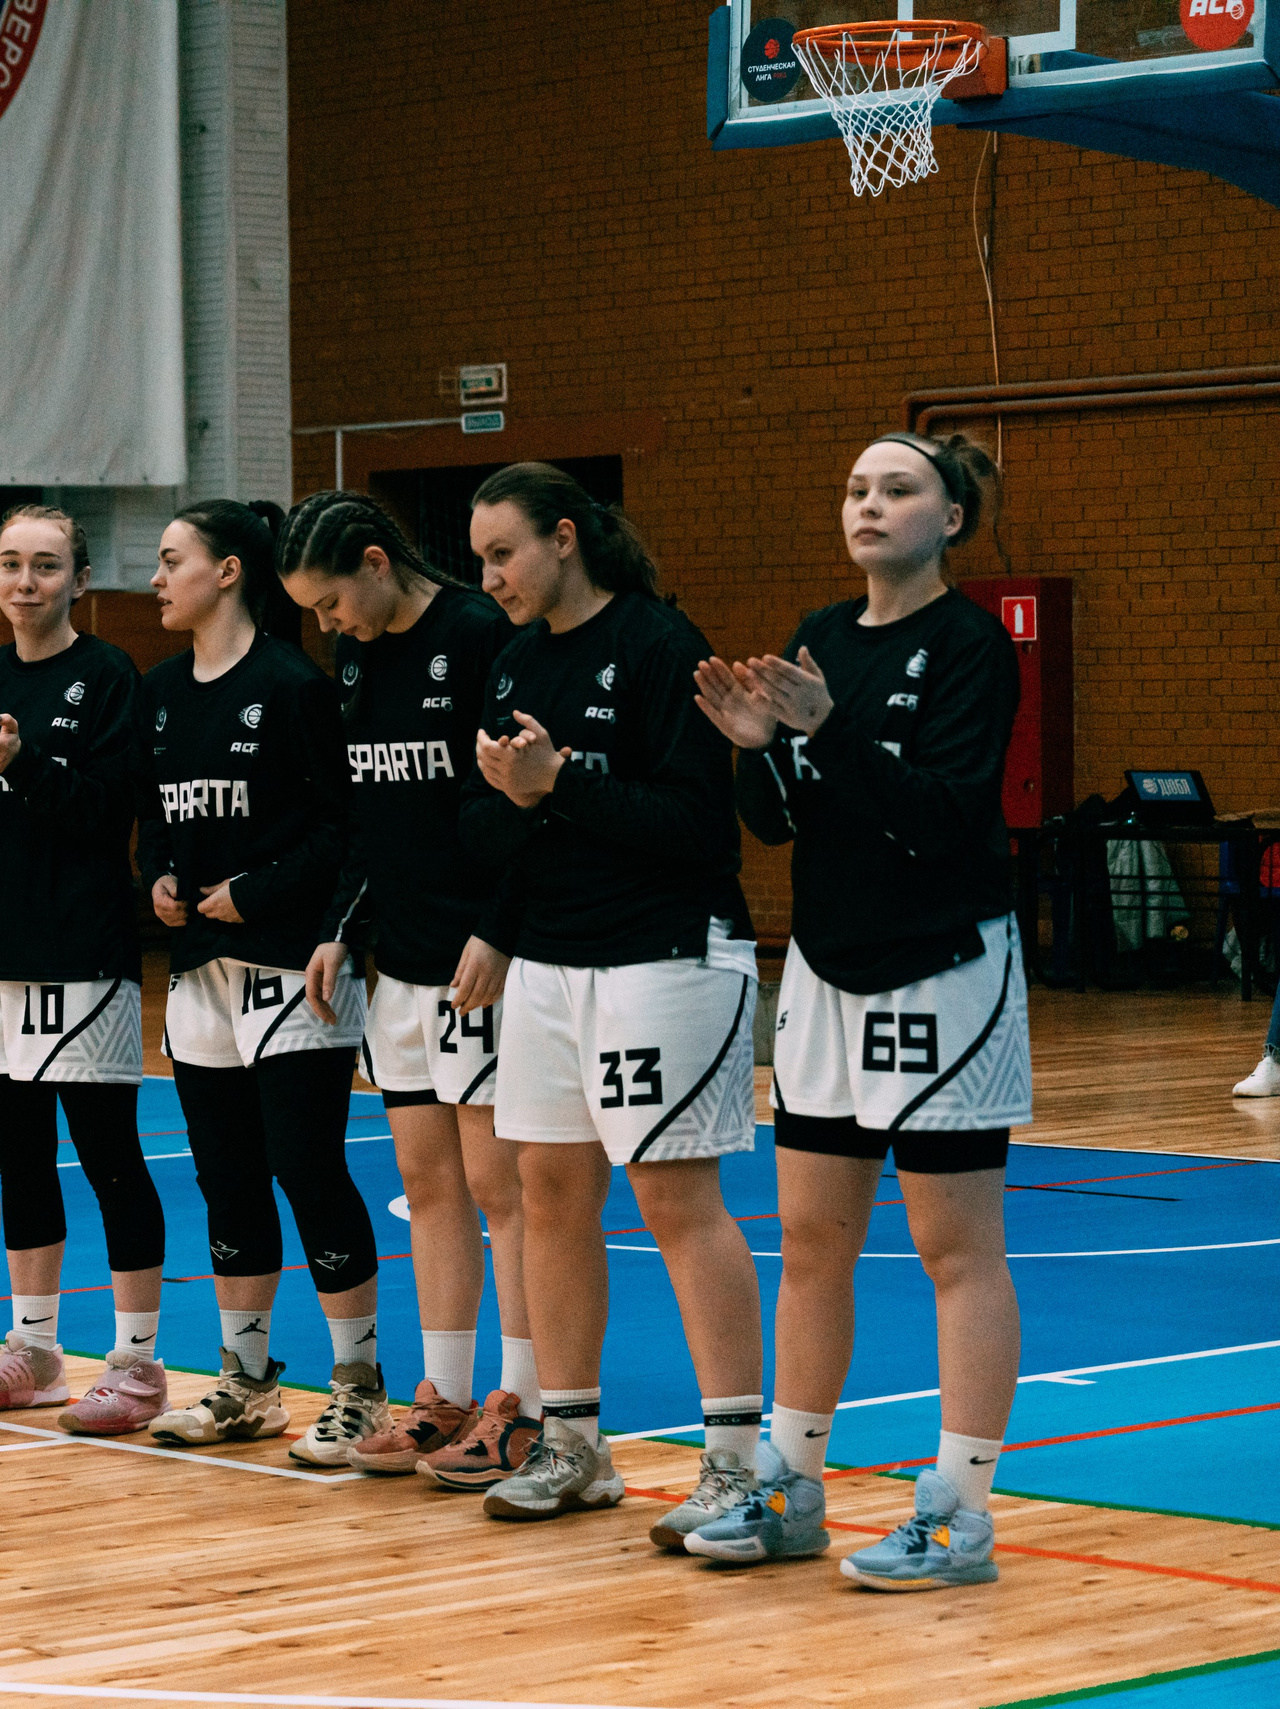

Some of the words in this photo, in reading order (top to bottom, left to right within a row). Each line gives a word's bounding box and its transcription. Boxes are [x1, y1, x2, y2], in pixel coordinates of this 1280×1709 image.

[747, 61, 796, 74] СТУДЕНЧЕСКАЯ
[755, 73, 772, 82] ЛИГА
[347, 740, 455, 783] SPARTA
[21, 984, 65, 1035] 10
[437, 999, 495, 1054] 24
[862, 1010, 939, 1074] 69
[599, 1046, 664, 1110] 33
